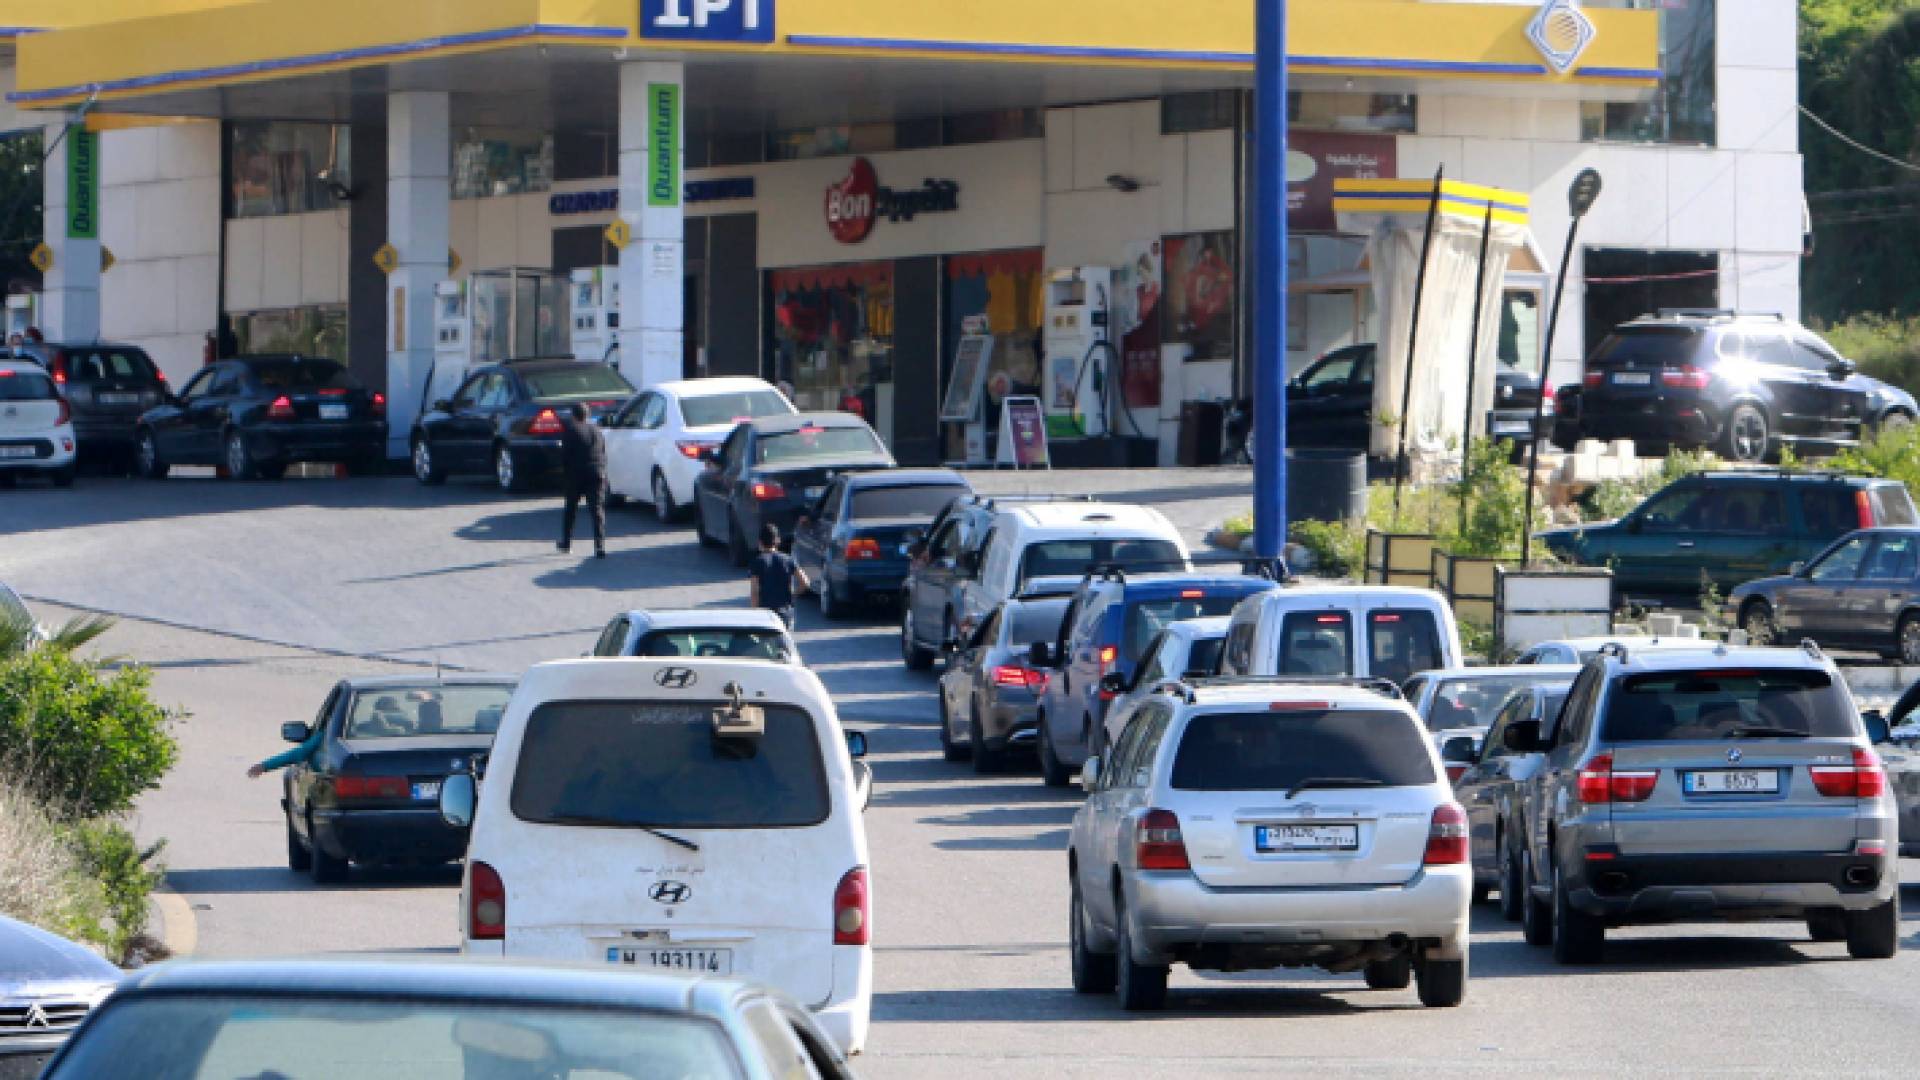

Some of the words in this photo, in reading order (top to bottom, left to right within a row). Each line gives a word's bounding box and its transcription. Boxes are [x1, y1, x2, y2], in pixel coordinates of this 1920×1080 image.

[73, 130, 90, 232] Quantum
[654, 90, 673, 200] Quantum
[828, 190, 871, 221] Bon
